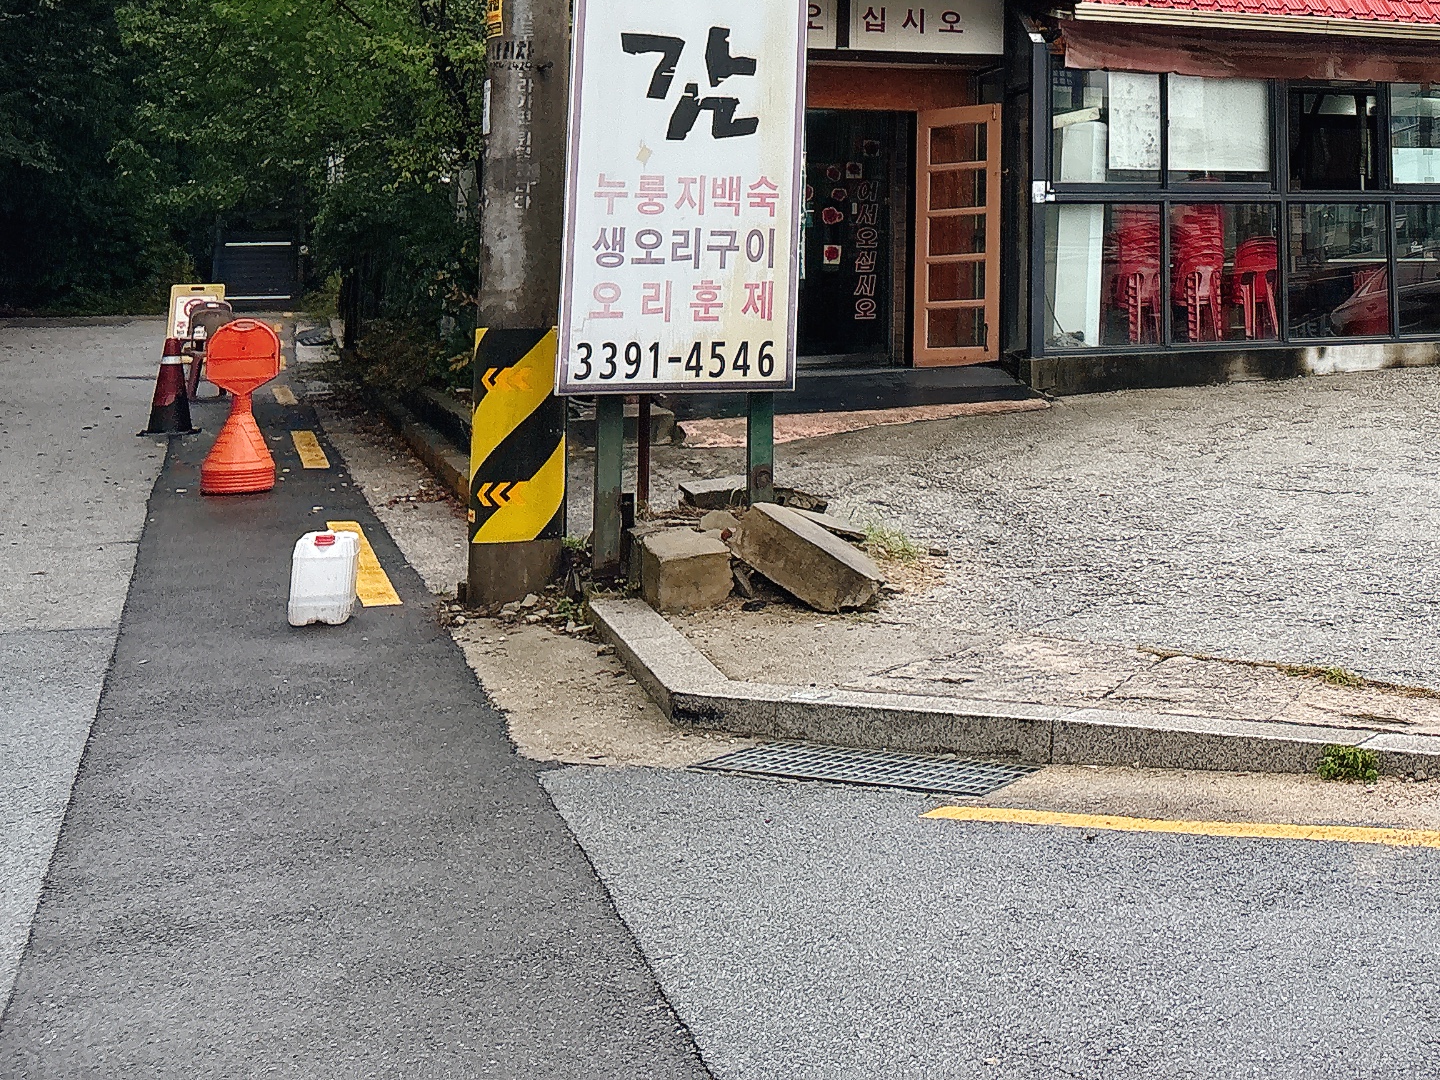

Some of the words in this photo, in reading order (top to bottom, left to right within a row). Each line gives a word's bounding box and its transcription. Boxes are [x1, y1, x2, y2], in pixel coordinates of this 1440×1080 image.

[863, 6, 963, 34] 십시오
[593, 173, 780, 218] 누룽지백숙
[592, 227, 775, 269] 생오리구이
[854, 180, 879, 320] 어서오십시오
[574, 340, 775, 380] 3391-4546
